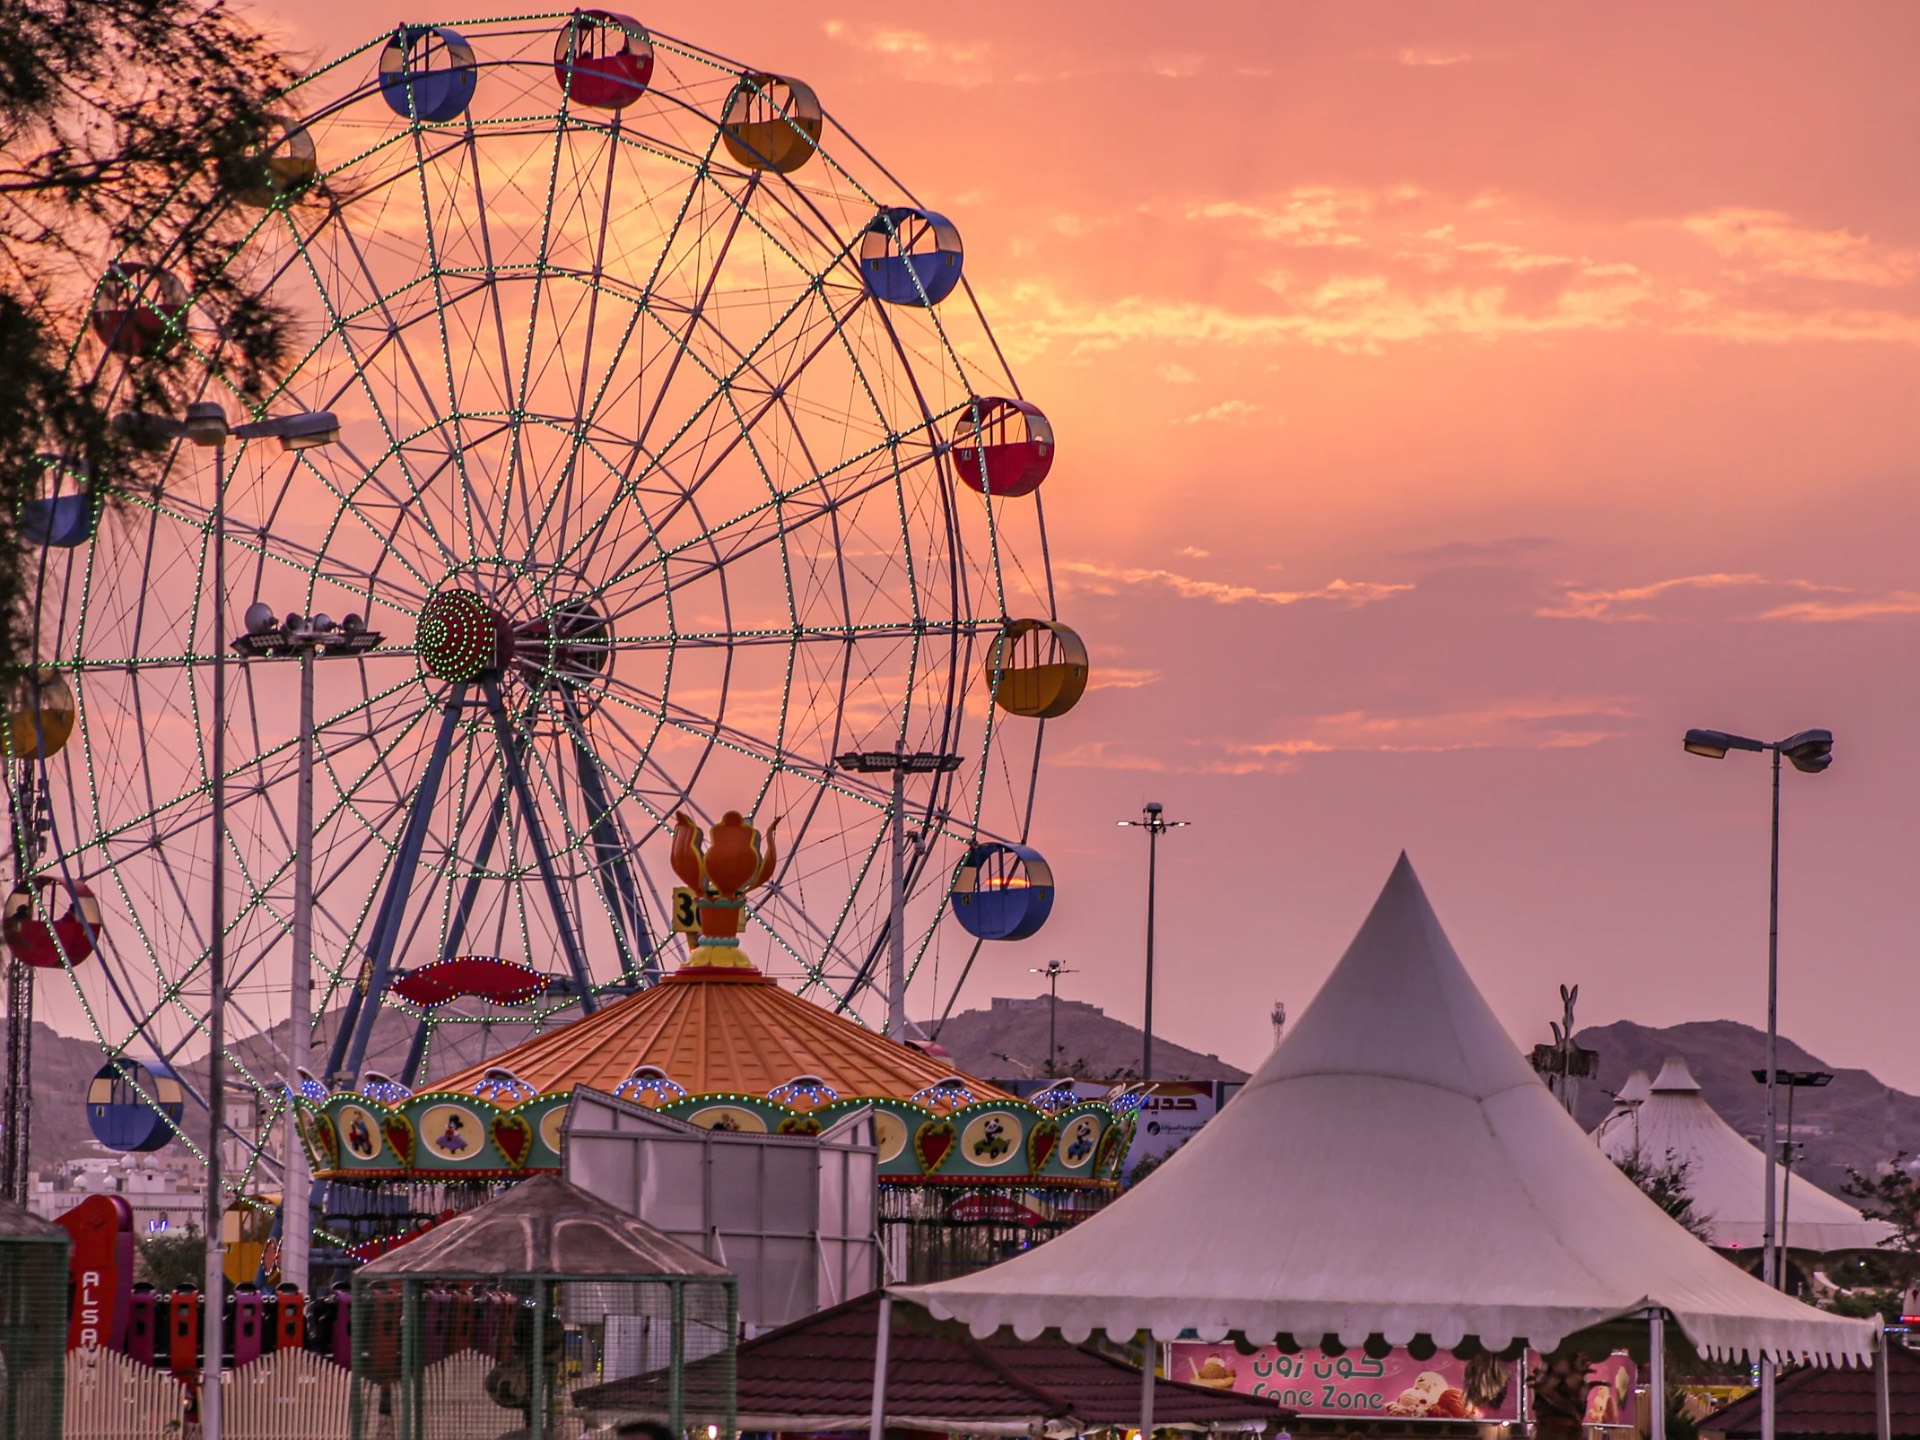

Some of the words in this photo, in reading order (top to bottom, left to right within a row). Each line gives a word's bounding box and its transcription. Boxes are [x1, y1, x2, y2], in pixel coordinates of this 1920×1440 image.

[677, 893, 701, 927] 3
[1253, 1353, 1304, 1378] زون
[1314, 1352, 1384, 1379] كون
[1321, 1385, 1383, 1409] Zone
